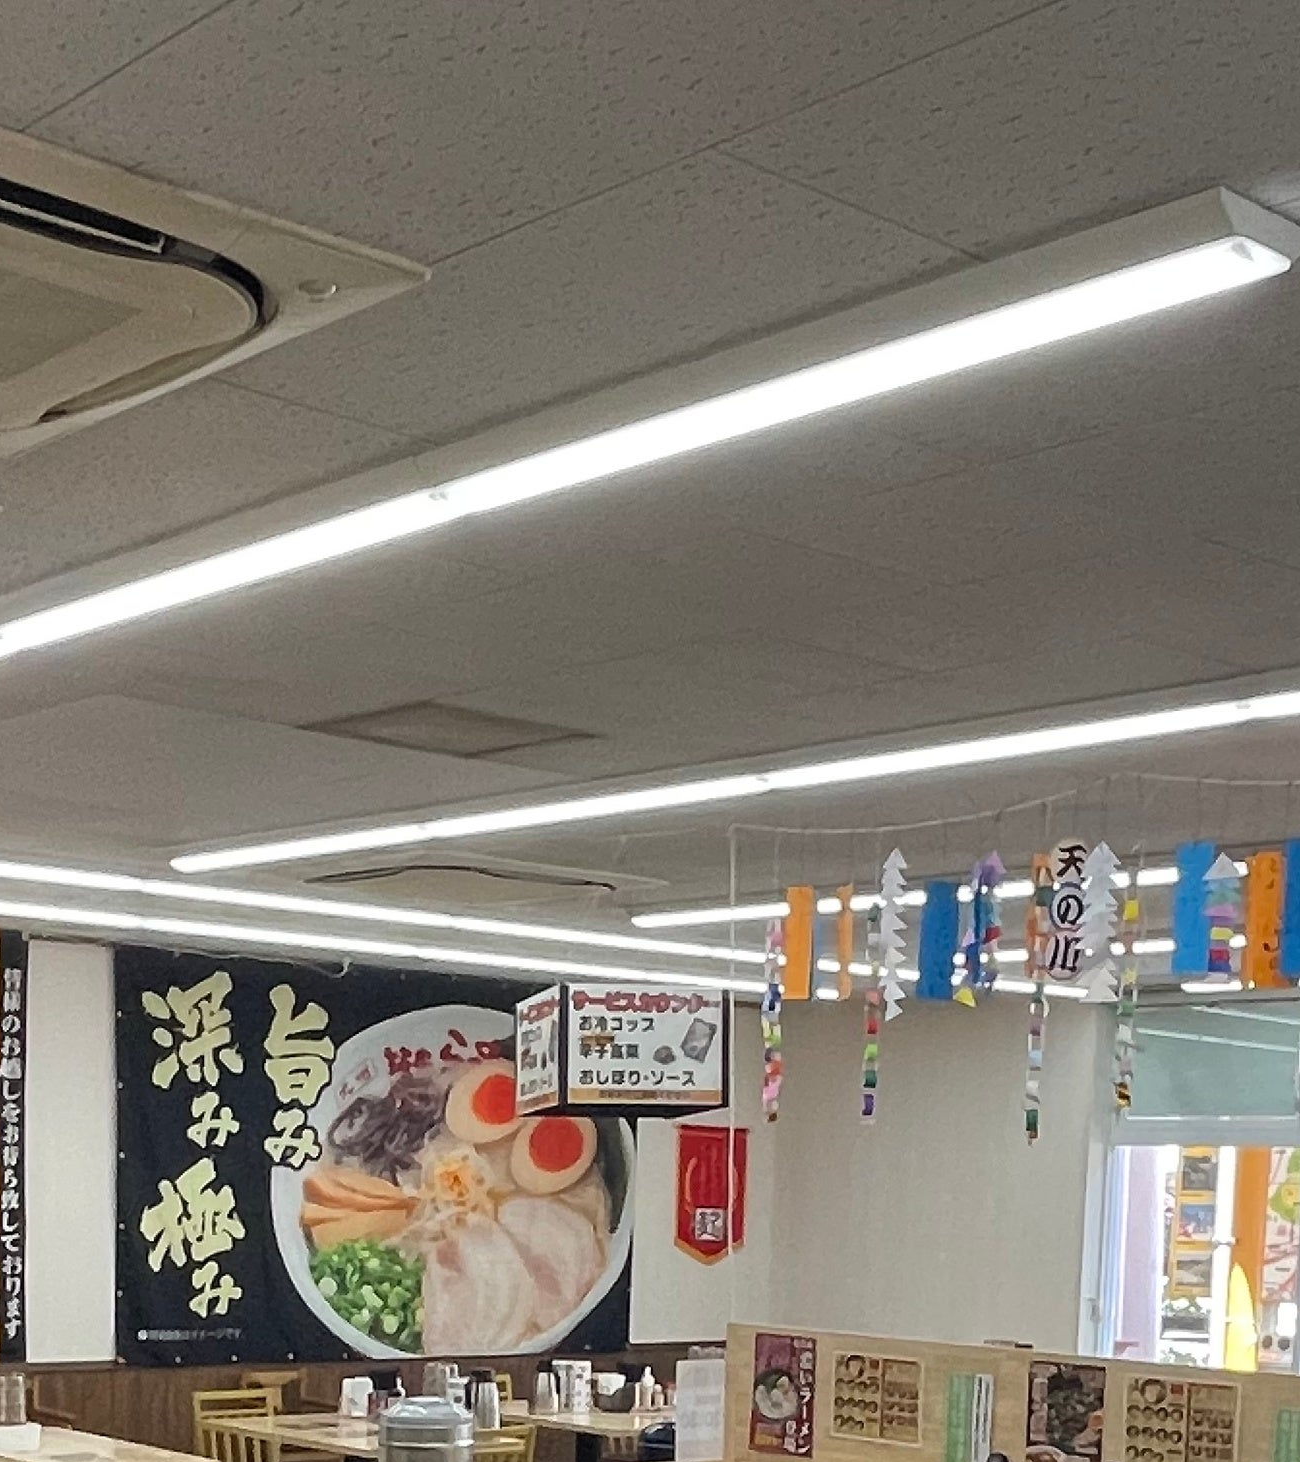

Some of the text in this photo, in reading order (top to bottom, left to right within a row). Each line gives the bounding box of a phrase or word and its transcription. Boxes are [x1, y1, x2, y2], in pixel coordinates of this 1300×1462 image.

[1048, 844, 1087, 973] 天の川
[139, 970, 247, 1318] 深み極み
[262, 984, 336, 1168] 旨み
[578, 1068, 697, 1087] おしぼり・ソース
